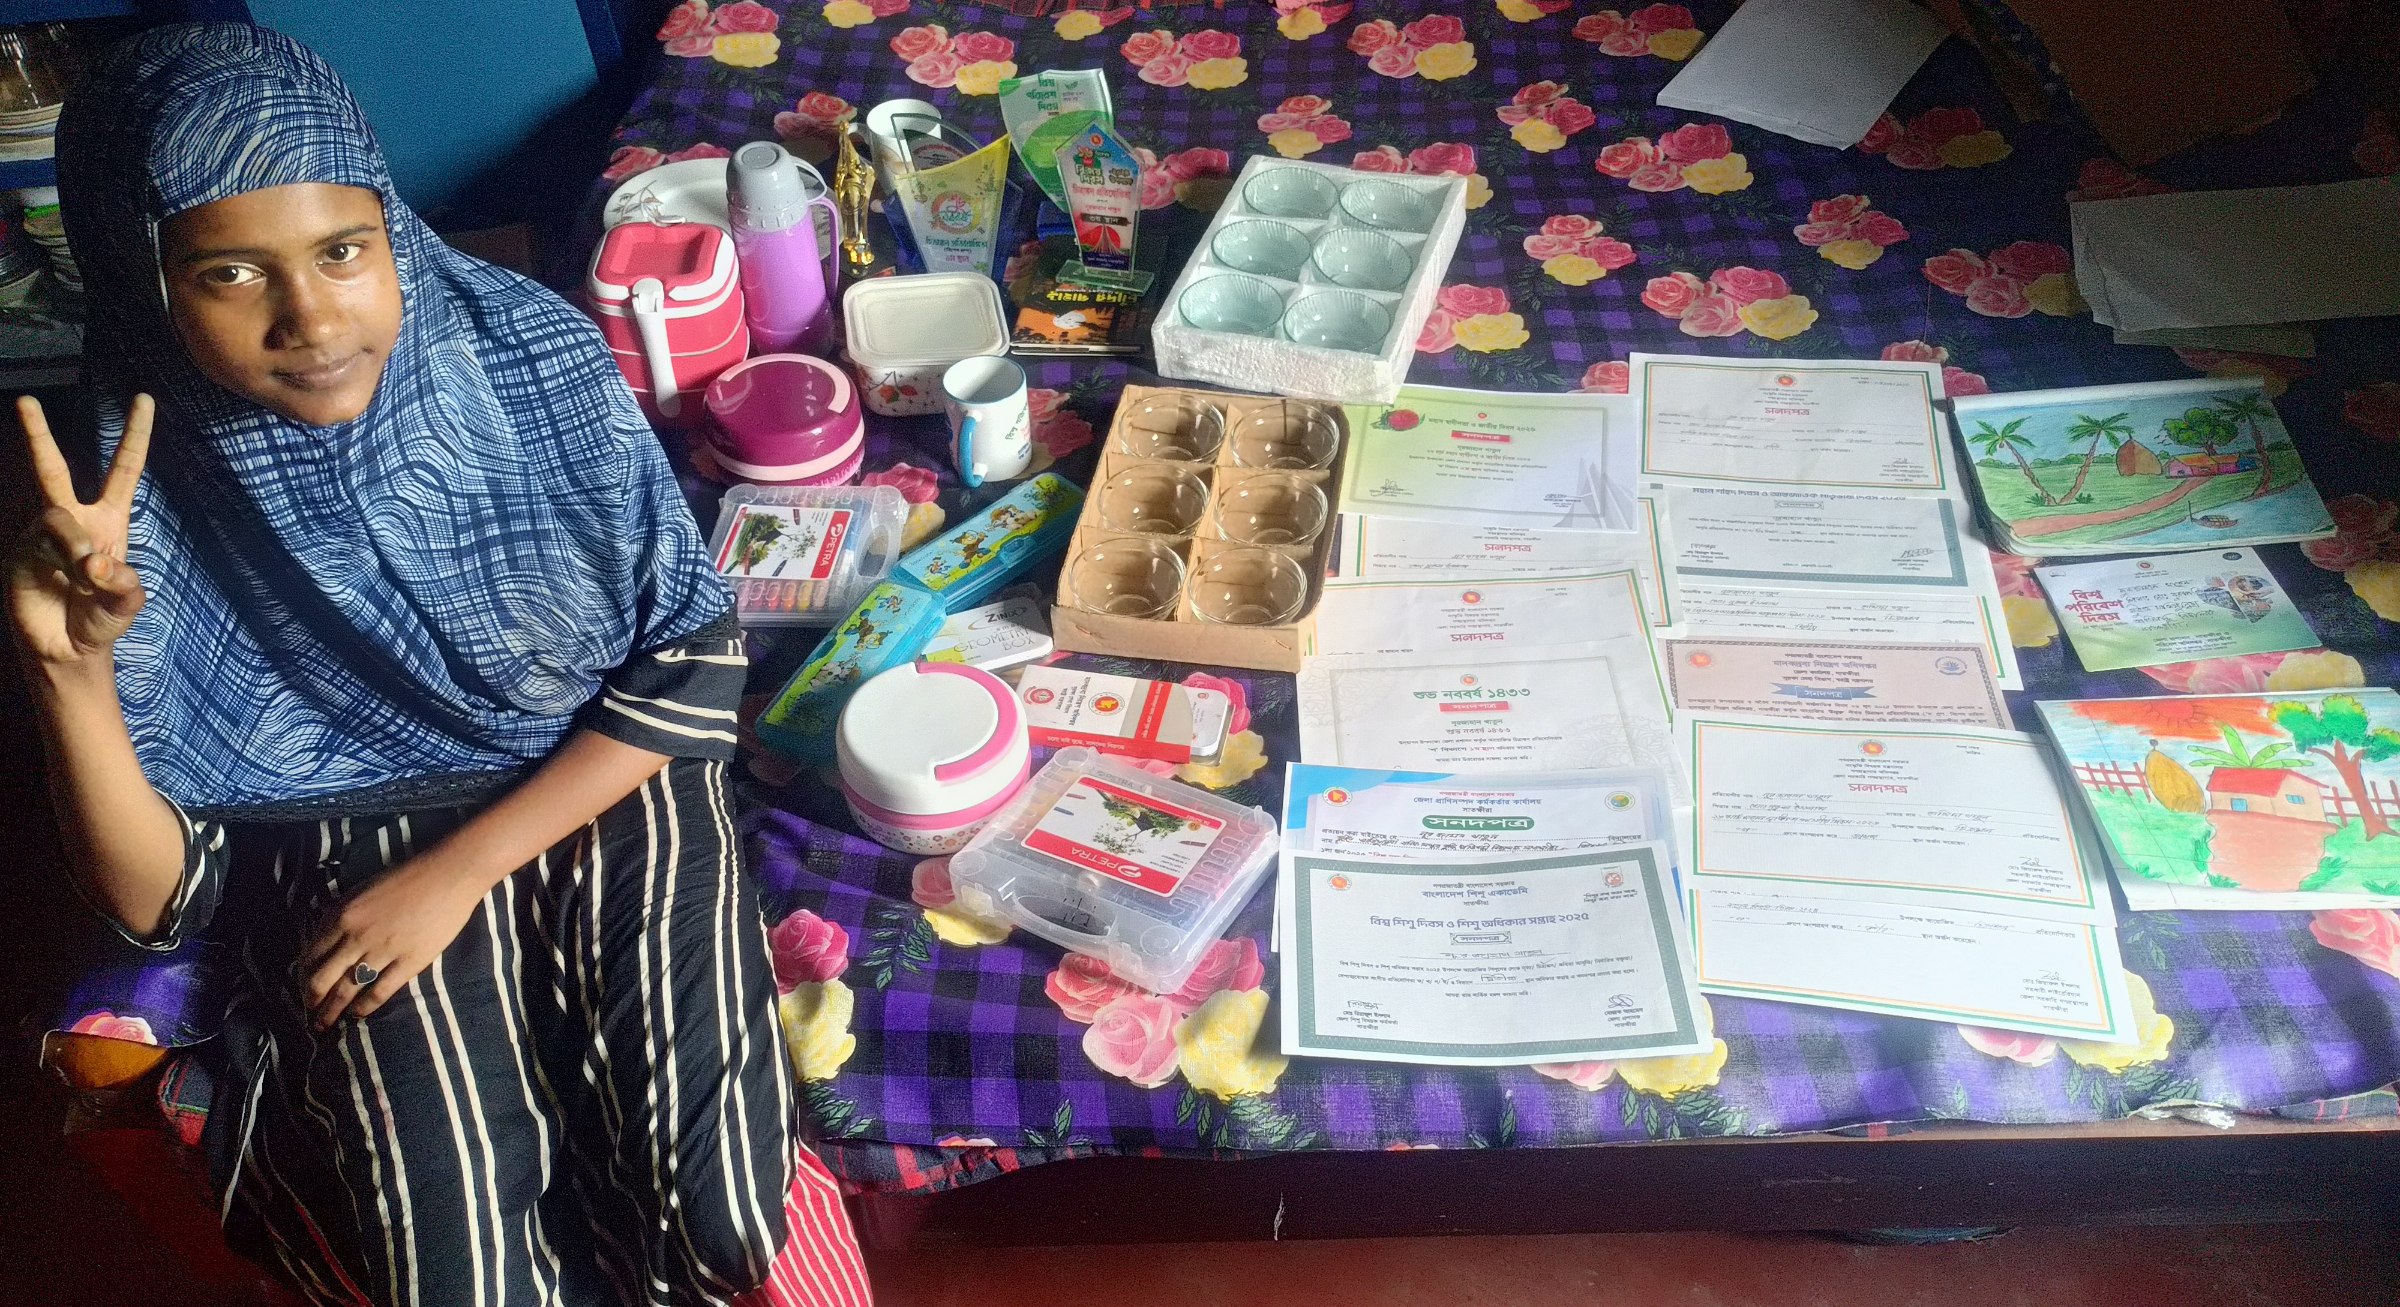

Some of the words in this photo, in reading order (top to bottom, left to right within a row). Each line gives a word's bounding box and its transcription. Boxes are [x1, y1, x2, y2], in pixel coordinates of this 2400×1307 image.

[820, 537, 838, 567] PETRA
[1484, 543, 1532, 553] সনদপত্র
[2070, 589, 2102, 600] বিশ্ব
[2066, 600, 2124, 612] পরিবেশ
[2079, 612, 2121, 623] দিবস
[953, 626, 1030, 652] GEOMETRY
[1002, 636, 1035, 651] BOX
[1450, 632, 1505, 642] সনদপত্র
[1413, 691, 1437, 700] শুভ
[1441, 687, 1482, 699] নববর্ষ
[1488, 688, 1531, 699] ১৪৩৩
[1848, 783, 1908, 794] সনদপত্র
[1426, 816, 1530, 829] সনদপত্র
[1071, 846, 1117, 870] PETRA
[1421, 890, 1464, 899] বাংলাদেশ
[1467, 889, 1486, 899] শিশু
[1488, 886, 1529, 897] একাডেমি
[1370, 915, 1391, 928] বিশ্ব
[1393, 916, 1416, 930] শিশু
[1417, 917, 1444, 929] দিবস
[1446, 920, 1455, 928] ও
[1457, 918, 1481, 931] শিশু
[1482, 917, 1526, 928] অধিকার
[1528, 914, 1556, 926] সপ্তাহ
[1558, 912, 1590, 923] ২০২৫
